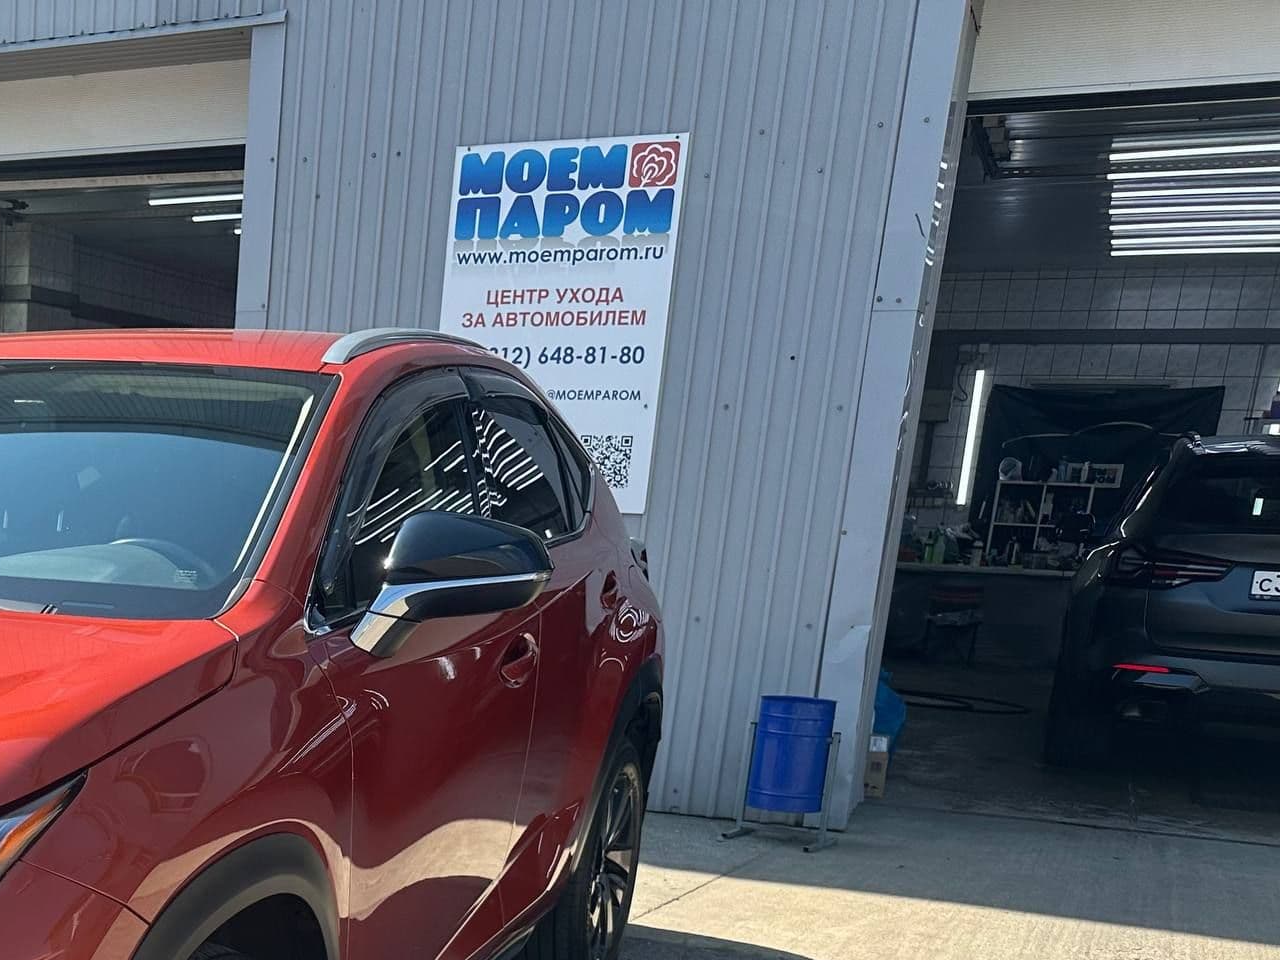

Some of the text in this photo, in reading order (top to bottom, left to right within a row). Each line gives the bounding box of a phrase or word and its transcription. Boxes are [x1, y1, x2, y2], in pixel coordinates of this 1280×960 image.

[459, 143, 628, 196] МОЕМ
[455, 188, 675, 240] ПАРОМ
[456, 245, 665, 266] www.moemparom.ru
[486, 286, 625, 308] ЦЕНТР УХОДА
[461, 309, 647, 328] ЗА АВТОМОБИЛЕМ
[538, 345, 646, 365] 648-81-80
[547, 389, 642, 401] @MOEMPAROM
